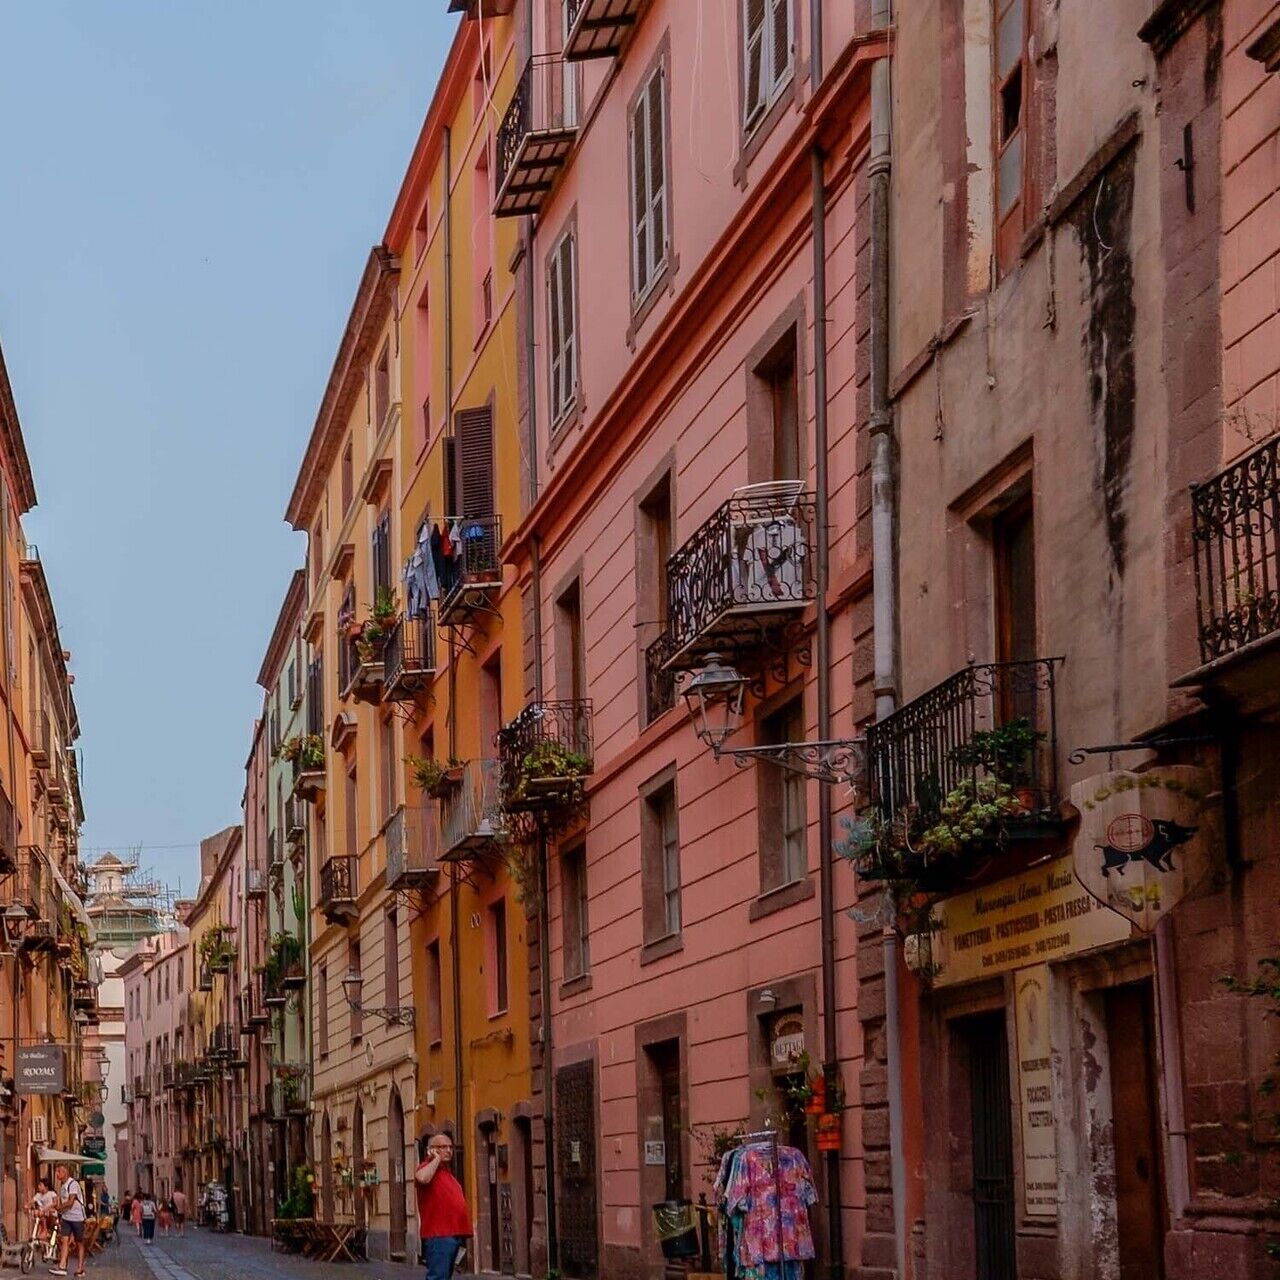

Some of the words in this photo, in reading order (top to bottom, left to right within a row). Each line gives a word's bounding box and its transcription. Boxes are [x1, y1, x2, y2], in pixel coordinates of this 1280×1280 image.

[1044, 903, 1066, 926] PASTA
[1066, 895, 1091, 919] FRESCA
[23, 1067, 56, 1077] ROOMS
